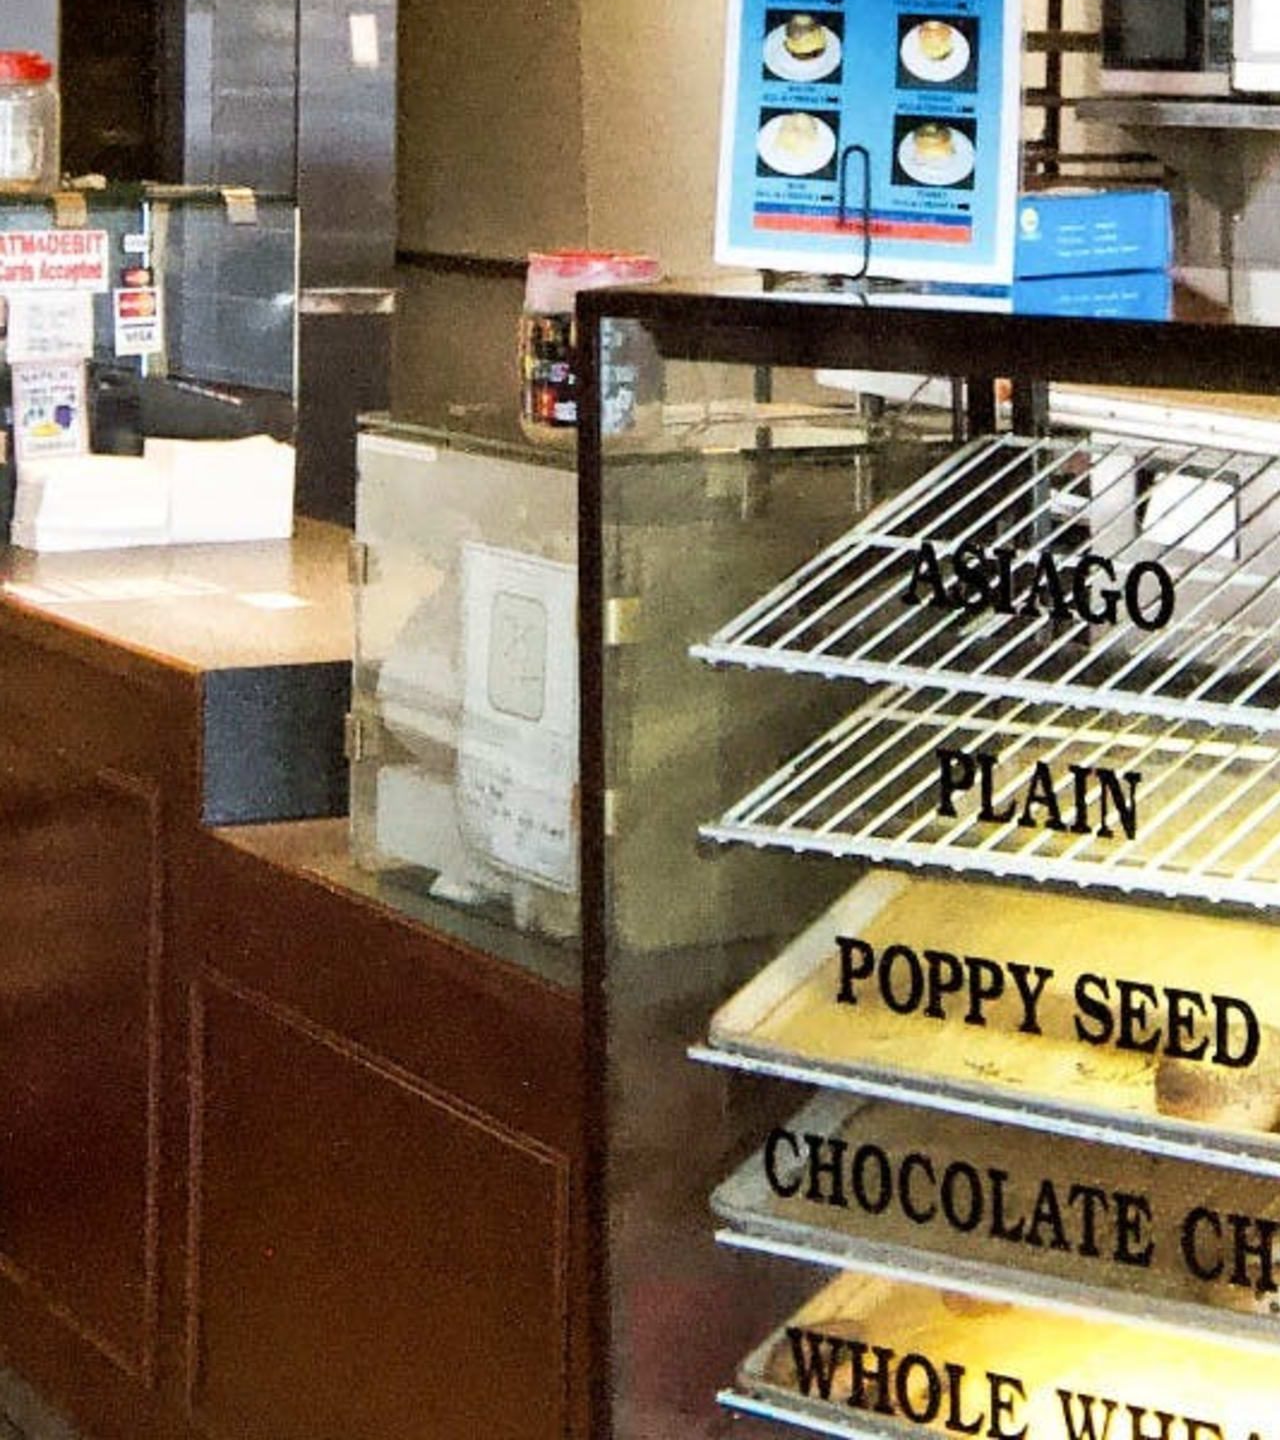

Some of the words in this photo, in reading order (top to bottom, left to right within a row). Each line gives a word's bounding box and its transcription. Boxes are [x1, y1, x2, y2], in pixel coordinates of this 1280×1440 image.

[901, 541, 1175, 632] ASIAGO
[935, 749, 1142, 842] PLAIN
[835, 936, 1055, 1035] POPPY
[1074, 970, 1261, 1070] SEED
[764, 1128, 1153, 1268] CHOCOLATE
[786, 1326, 1030, 1440] WHOLE
